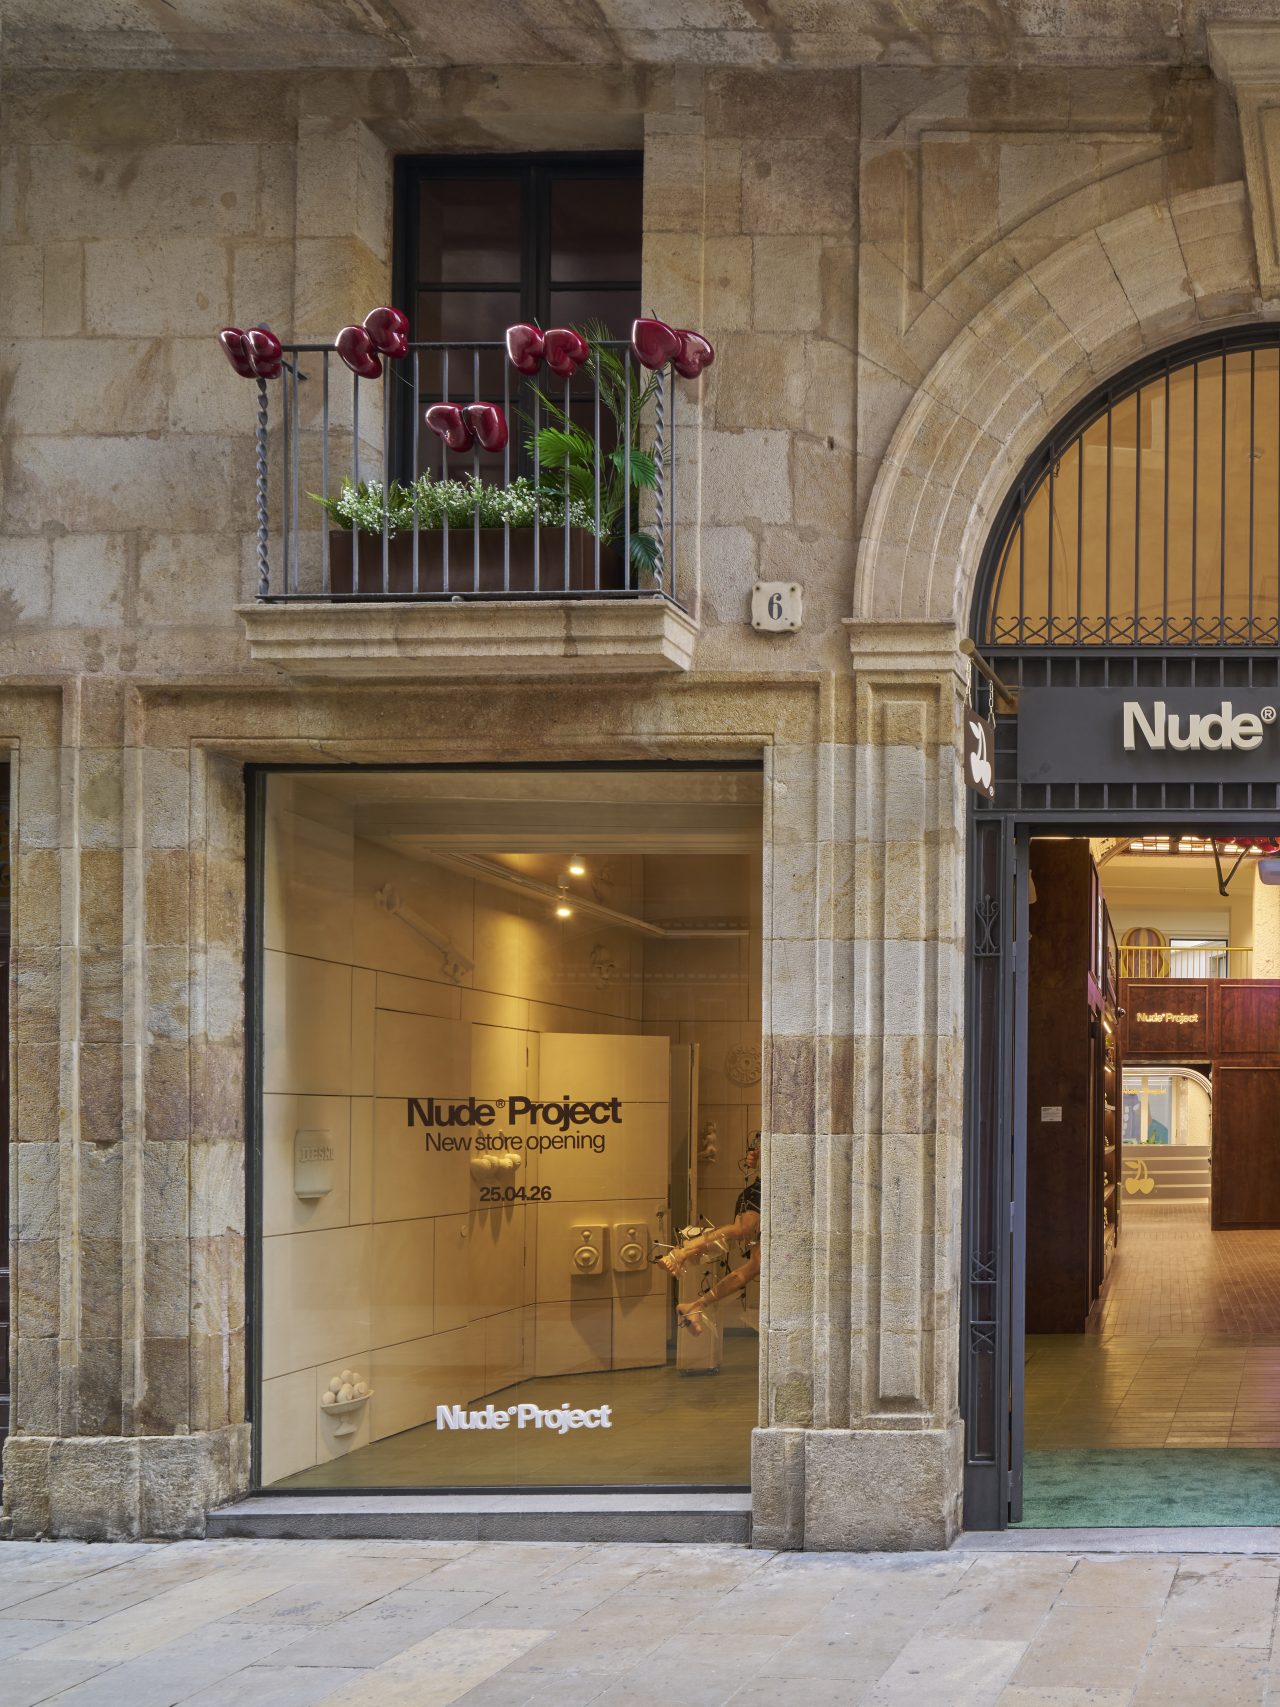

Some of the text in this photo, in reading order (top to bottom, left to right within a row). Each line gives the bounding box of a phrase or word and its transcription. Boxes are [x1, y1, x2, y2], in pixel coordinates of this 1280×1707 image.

[1165, 1012, 1199, 1025] Project
[508, 1095, 623, 1132] Project
[425, 1131, 606, 1154] New store opening
[479, 1185, 552, 1202] 25.04.26
[517, 1403, 613, 1435] Project
